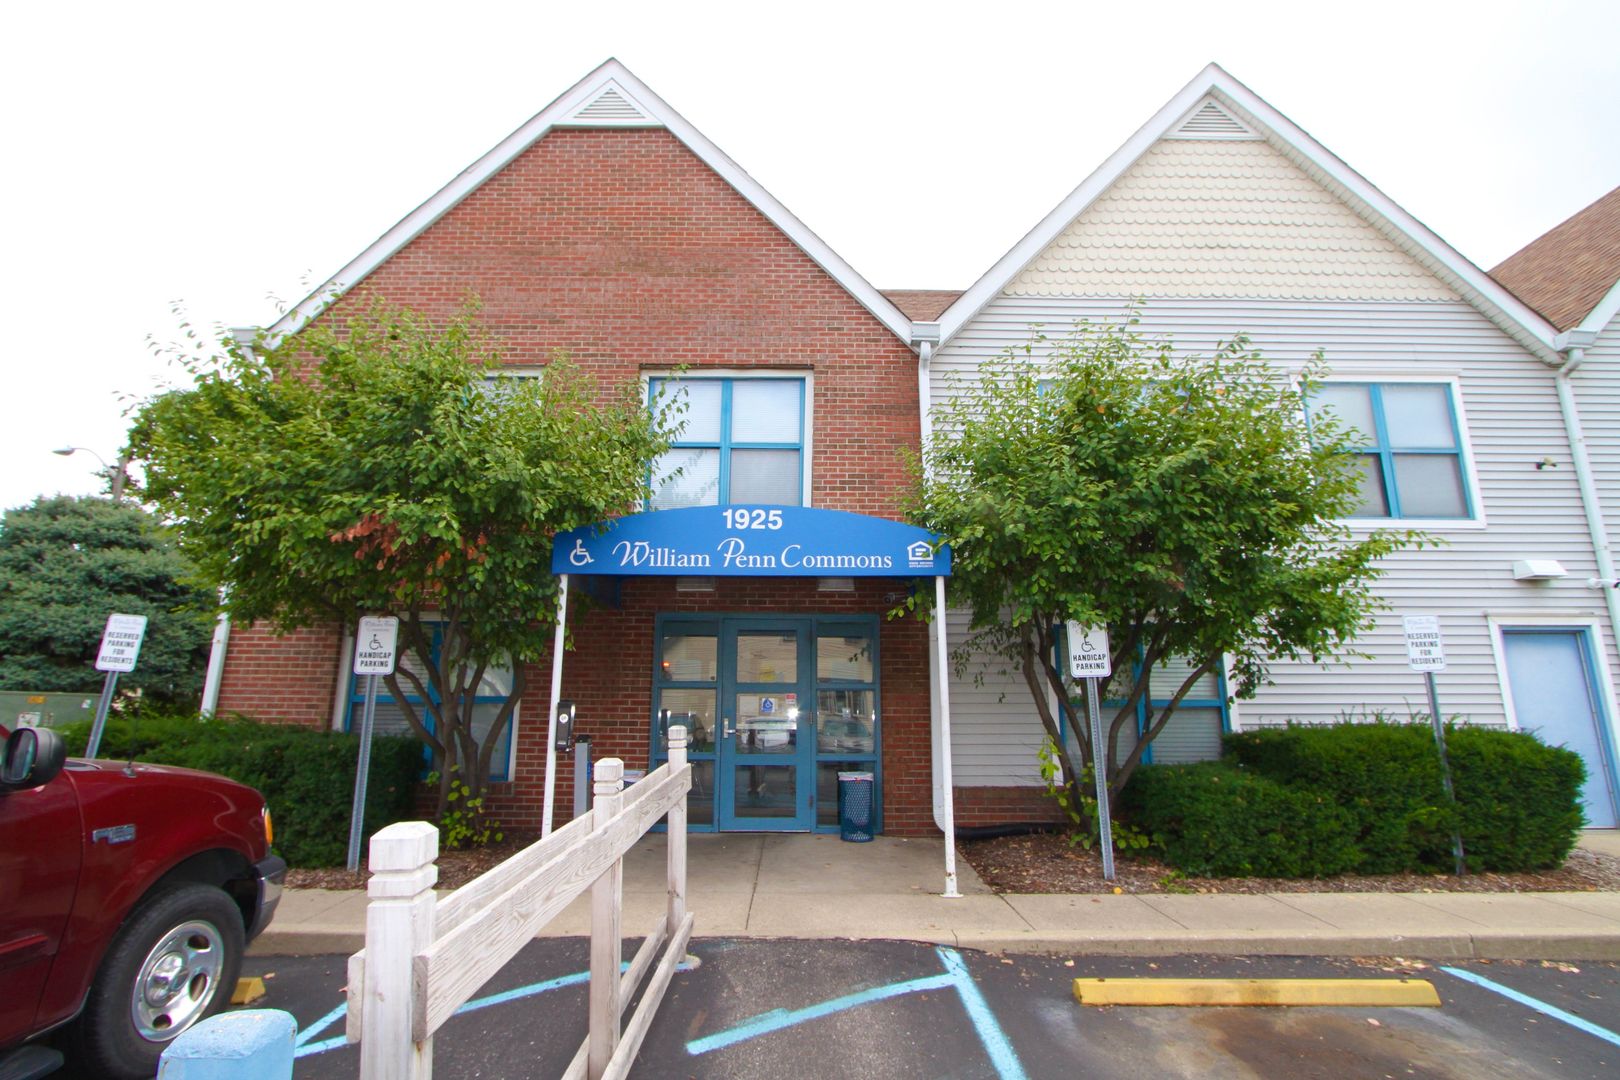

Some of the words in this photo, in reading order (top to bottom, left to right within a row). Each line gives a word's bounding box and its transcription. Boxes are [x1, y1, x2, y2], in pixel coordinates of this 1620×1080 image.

[722, 508, 783, 530] 1925
[612, 540, 711, 567] William
[717, 537, 777, 568] Penn
[781, 544, 892, 568] Commons
[107, 631, 140, 640] RESERVED
[1407, 632, 1440, 640] RESERVED
[107, 639, 136, 648] PARKING
[1410, 640, 1438, 648] PARKING
[358, 651, 392, 659] HANDICAP
[1072, 653, 1106, 661] HANDICAP
[359, 660, 389, 668] PARKING
[1411, 657, 1443, 665] RESIDENTS
[1076, 662, 1105, 670] PARKING
